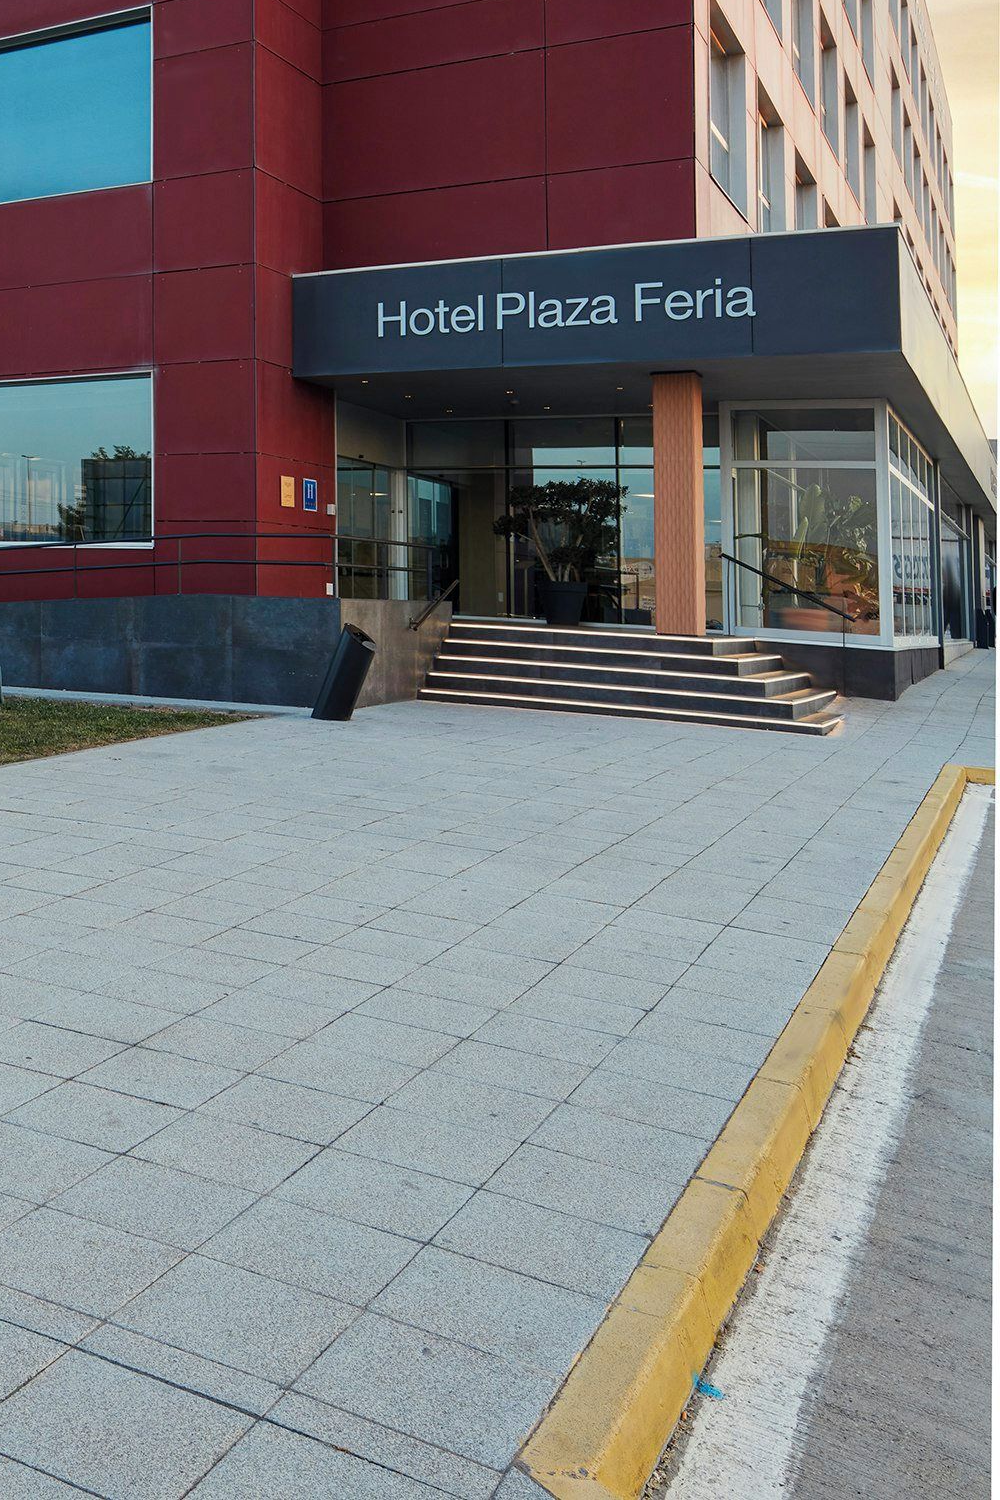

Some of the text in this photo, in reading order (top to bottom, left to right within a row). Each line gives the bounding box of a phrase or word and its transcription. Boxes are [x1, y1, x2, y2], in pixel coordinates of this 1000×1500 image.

[377, 278, 757, 338] Hotel Plaza Feria
[307, 483, 314, 499] H
